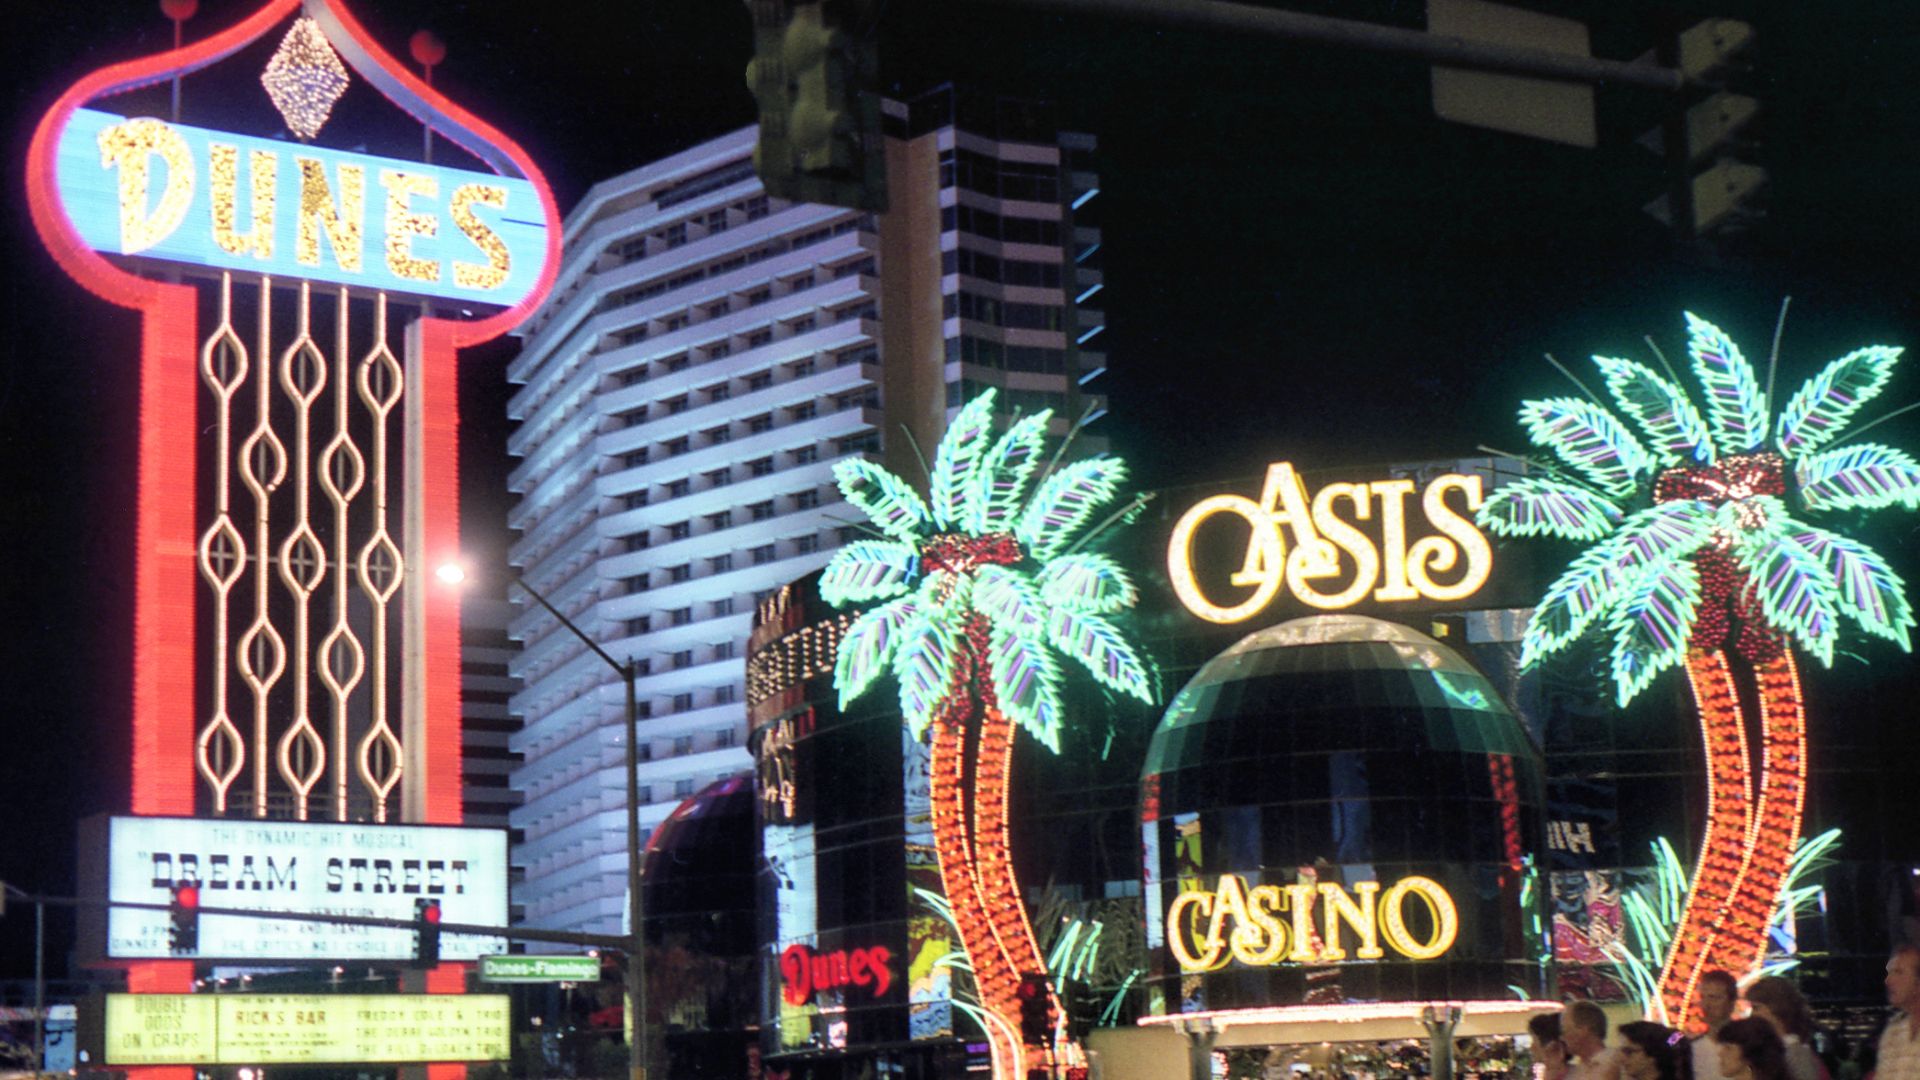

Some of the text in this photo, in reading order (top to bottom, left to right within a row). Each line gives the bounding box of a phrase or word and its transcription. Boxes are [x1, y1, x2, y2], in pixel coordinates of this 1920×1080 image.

[97, 115, 512, 291] DUNES
[1166, 461, 1493, 625] OASIS
[213, 828, 415, 850] THE DYNAMIC HIT MUSICAL
[1166, 873, 1460, 972] CASINO
[484, 960, 599, 979] Dunes-Flamingo
[780, 943, 892, 1007] Dunes
[295, 1010, 327, 1026] BAR
[121, 1032, 200, 1049] ON CRAPS
